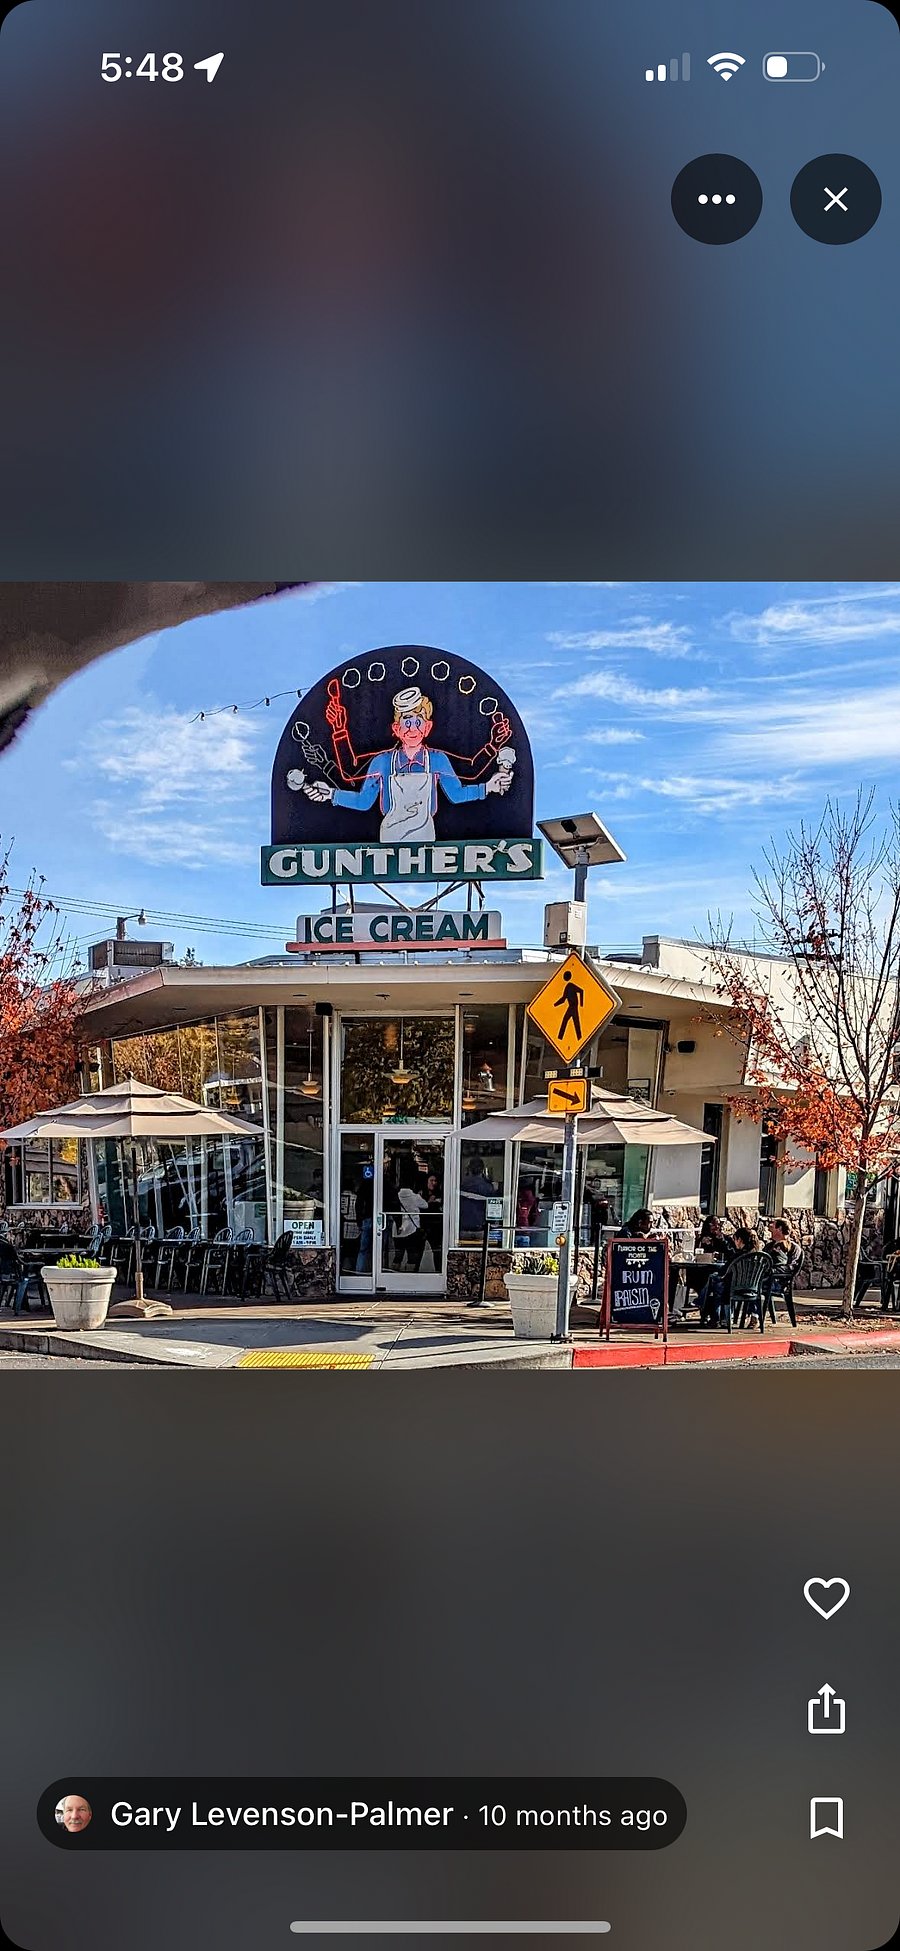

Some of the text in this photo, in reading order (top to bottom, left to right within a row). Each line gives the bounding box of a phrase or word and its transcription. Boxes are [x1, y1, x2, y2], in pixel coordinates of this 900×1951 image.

[269, 840, 533, 878] GUNTHER'S
[304, 914, 489, 944] ICE CREAM
[622, 1269, 653, 1285] RUM
[614, 1287, 650, 1307] RAISIN
